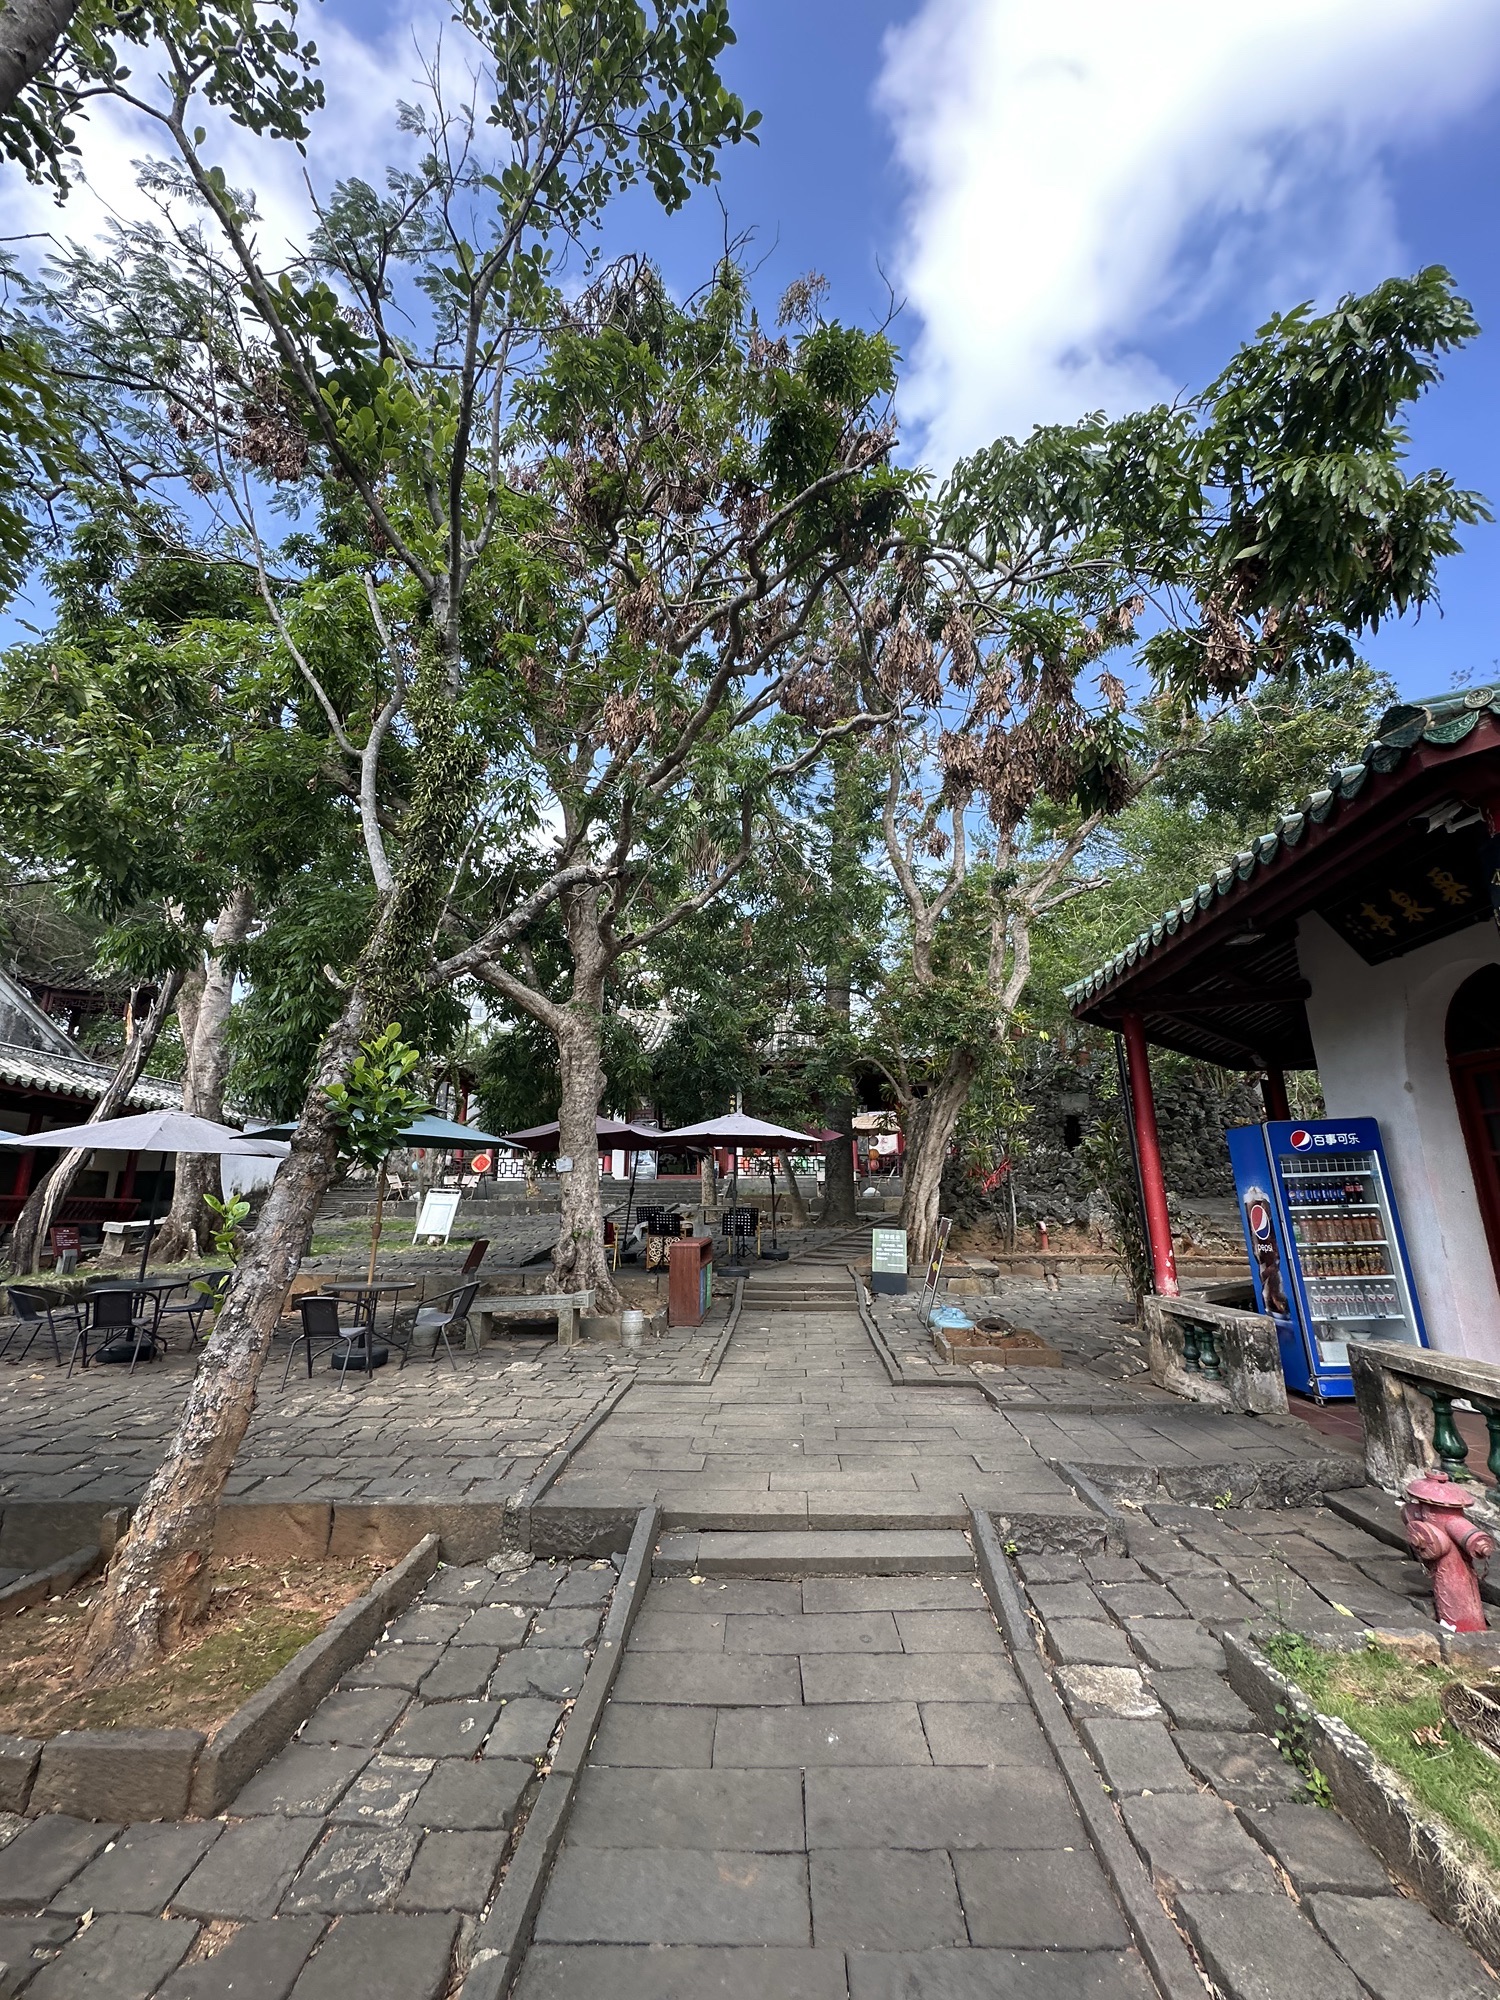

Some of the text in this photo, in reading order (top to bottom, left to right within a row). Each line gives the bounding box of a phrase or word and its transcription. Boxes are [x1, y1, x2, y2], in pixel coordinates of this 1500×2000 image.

[1313, 1133, 1361, 1146] 百事可乐
[1257, 1243, 1274, 1254] pepsi
